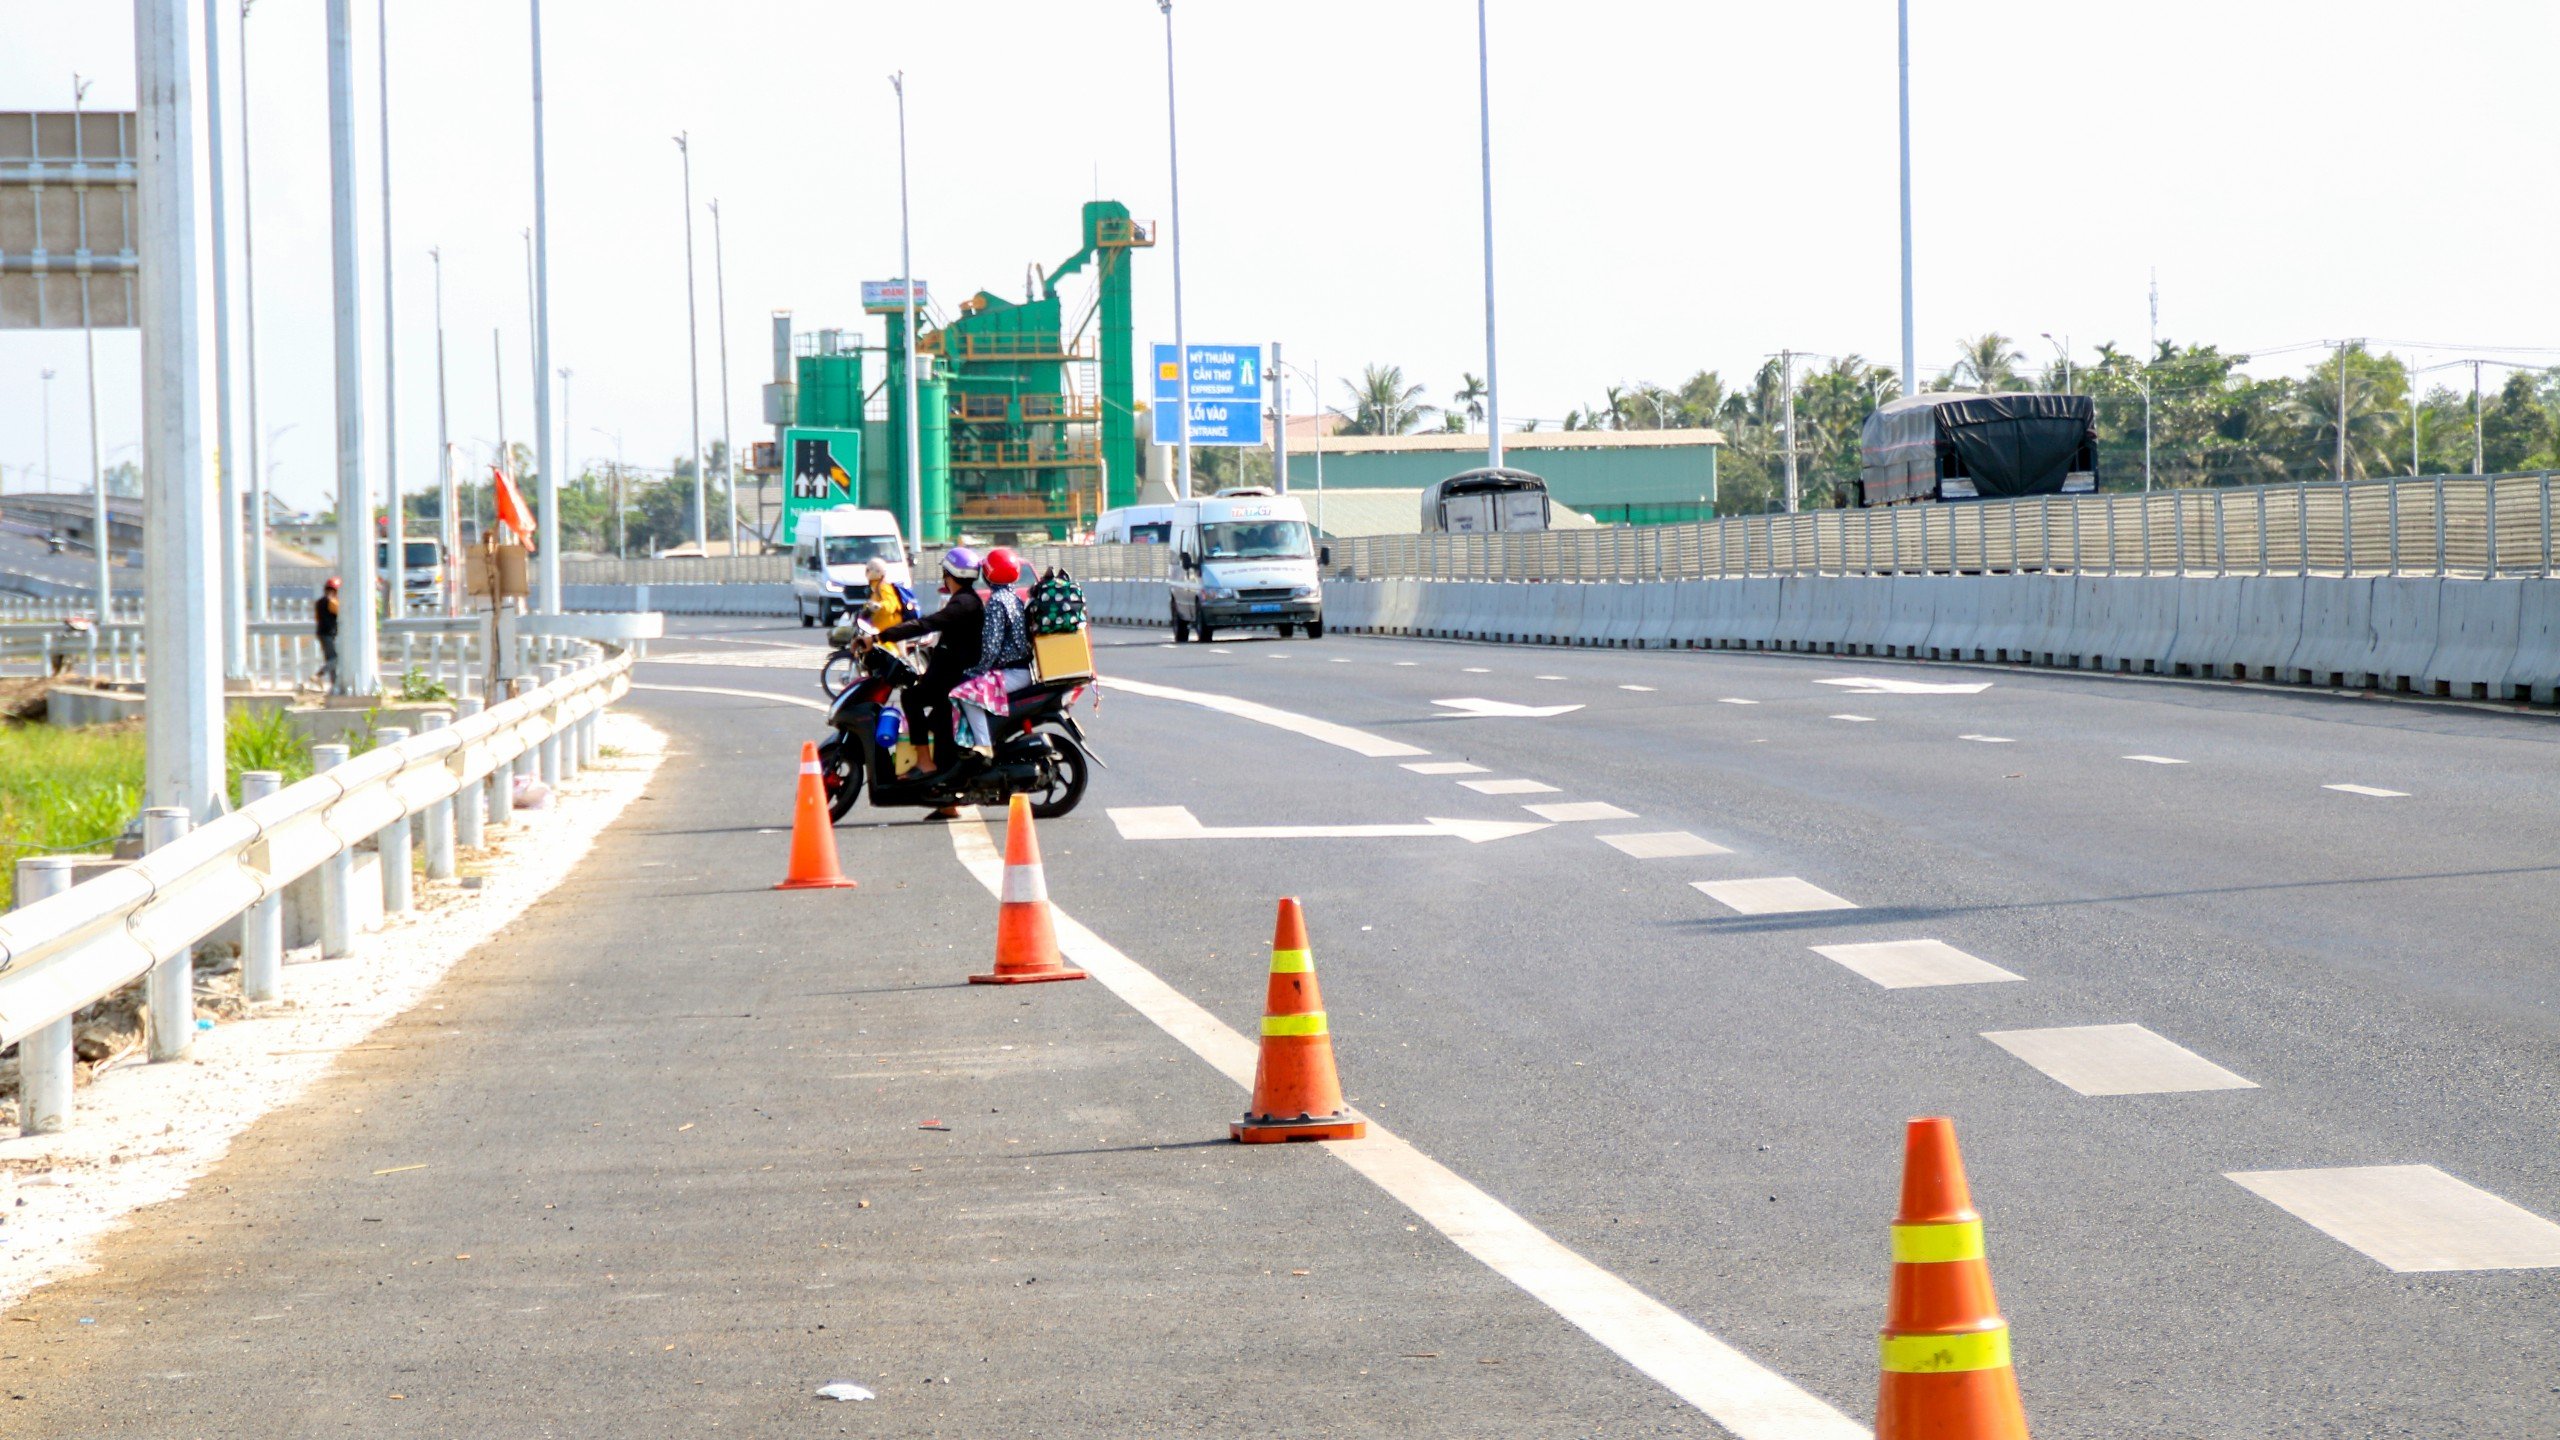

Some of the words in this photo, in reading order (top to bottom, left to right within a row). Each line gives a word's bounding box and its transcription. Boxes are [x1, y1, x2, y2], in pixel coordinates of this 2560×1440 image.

[1190, 351, 1203, 363] MỸ
[1205, 351, 1234, 366] THUẬN
[1193, 366, 1212, 380] CẦN
[1213, 369, 1232, 380] THƠ
[1188, 402, 1205, 421] LỐI
[1206, 405, 1228, 421] VÀO
